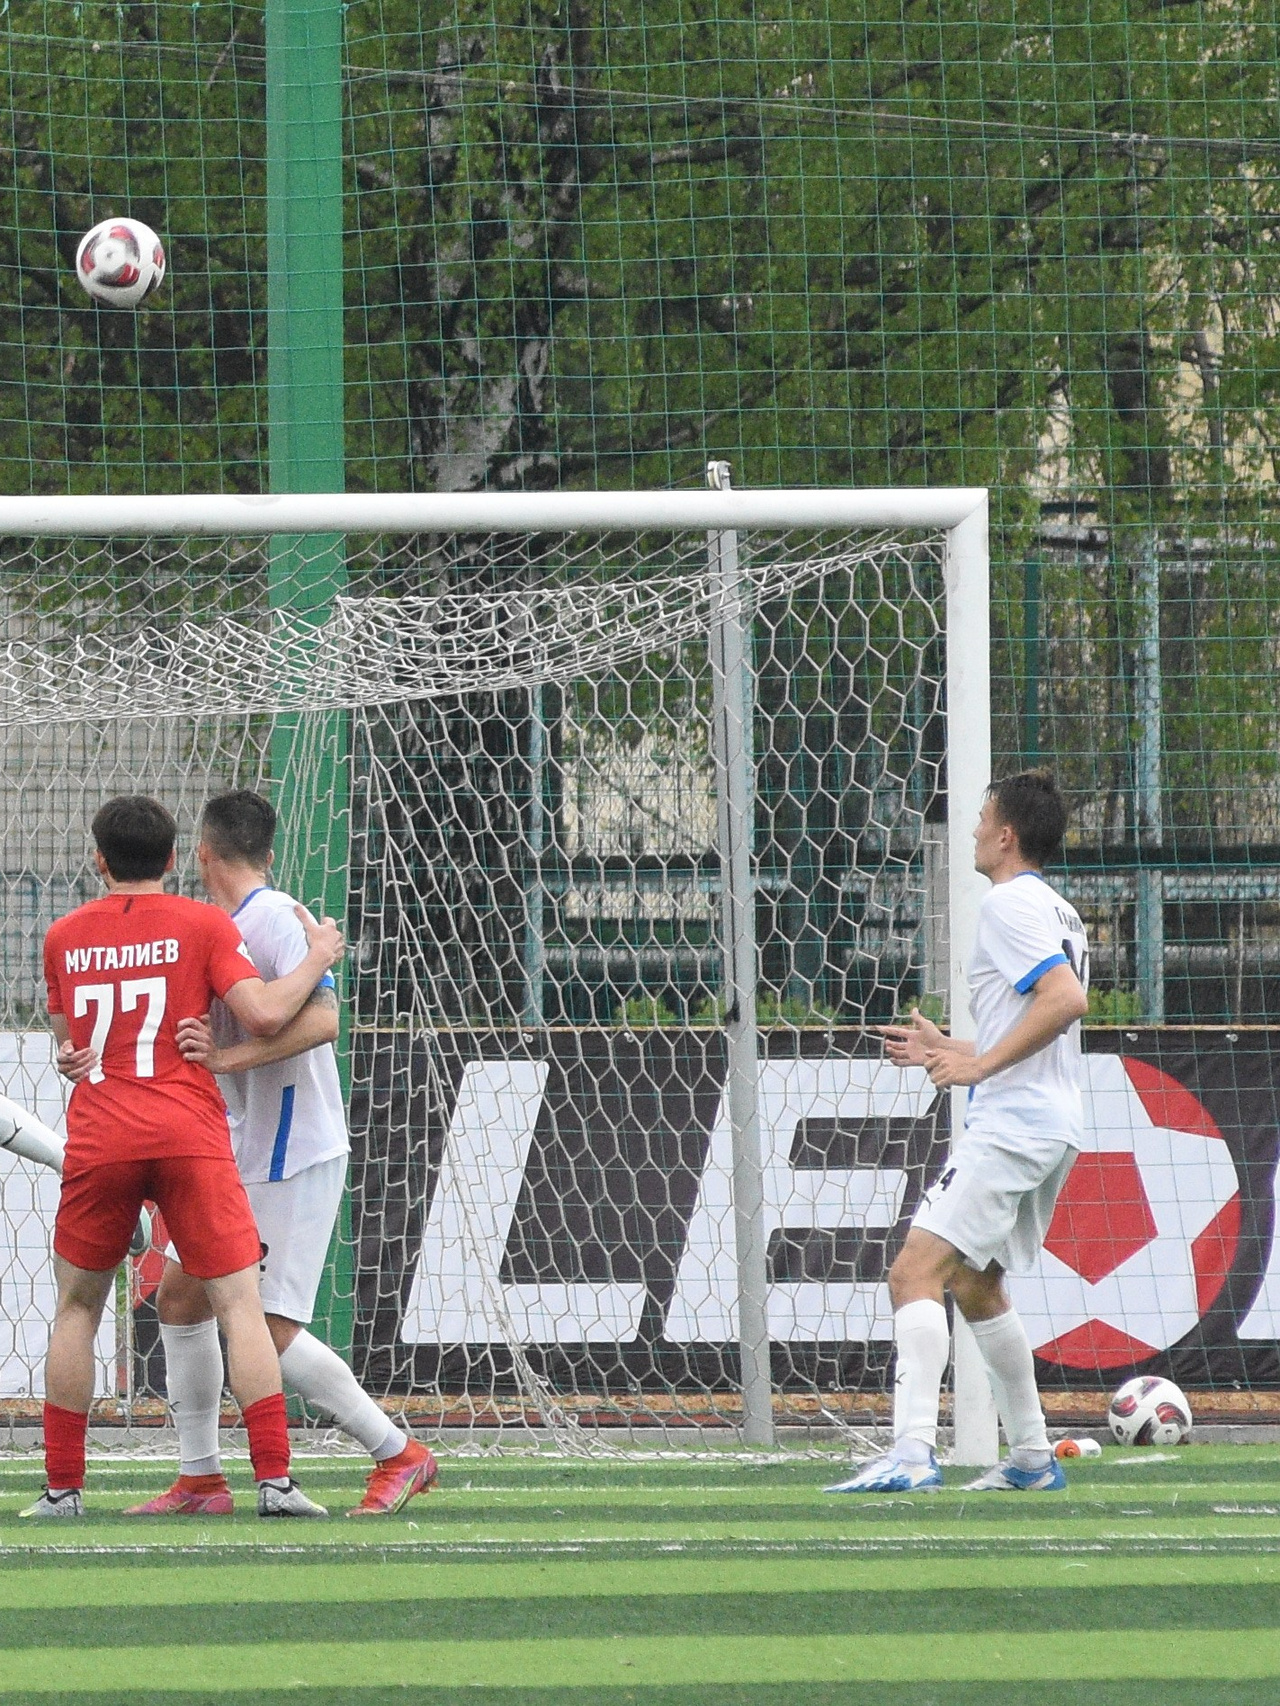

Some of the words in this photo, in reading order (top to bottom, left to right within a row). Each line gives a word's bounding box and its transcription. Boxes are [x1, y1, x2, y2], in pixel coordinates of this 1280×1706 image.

[65, 938, 180, 975] МУТАЛИЕВ
[74, 976, 167, 1085] 77
[934, 1166, 958, 1192] 4
